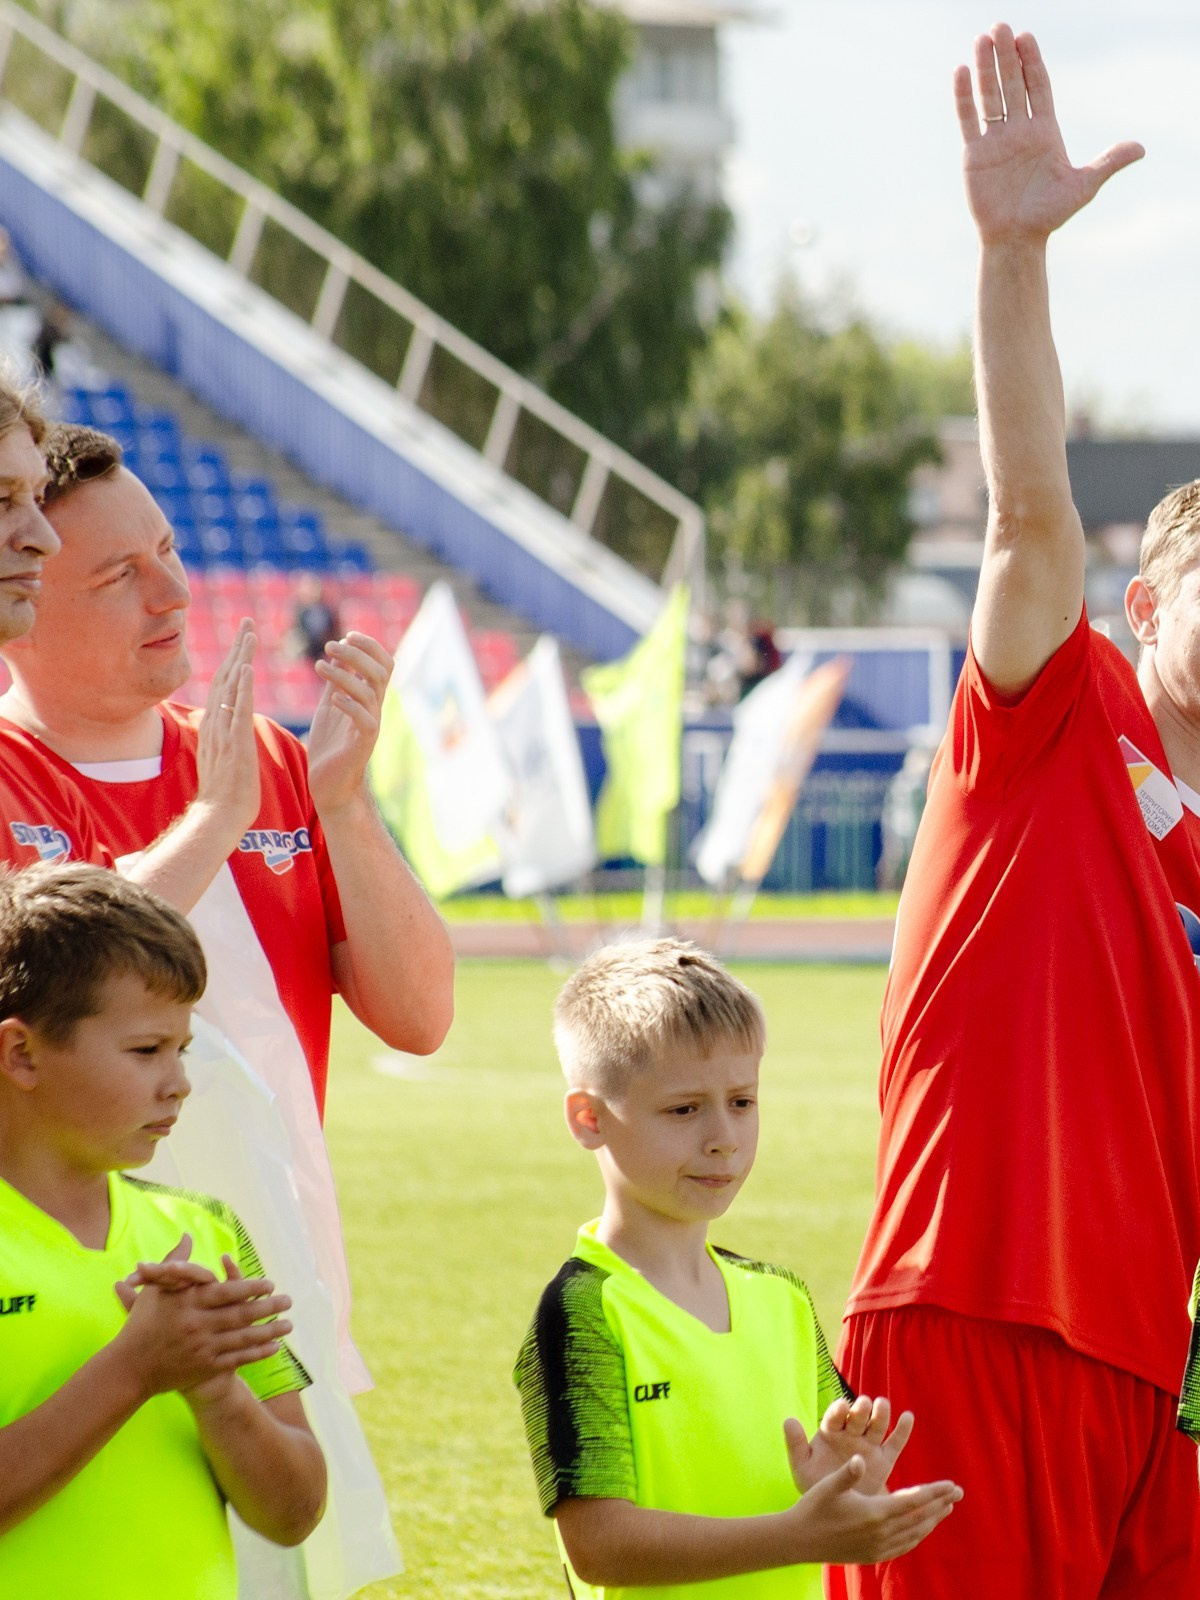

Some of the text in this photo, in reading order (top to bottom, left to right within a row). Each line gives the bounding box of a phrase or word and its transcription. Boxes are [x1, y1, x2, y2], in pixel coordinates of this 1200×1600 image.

[1139, 789, 1176, 824] ТЕРРИТОРИЯ
[1144, 814, 1164, 837] ТОМА
[0, 1295, 36, 1314] LIFF
[634, 1382, 671, 1402] CLIFF
